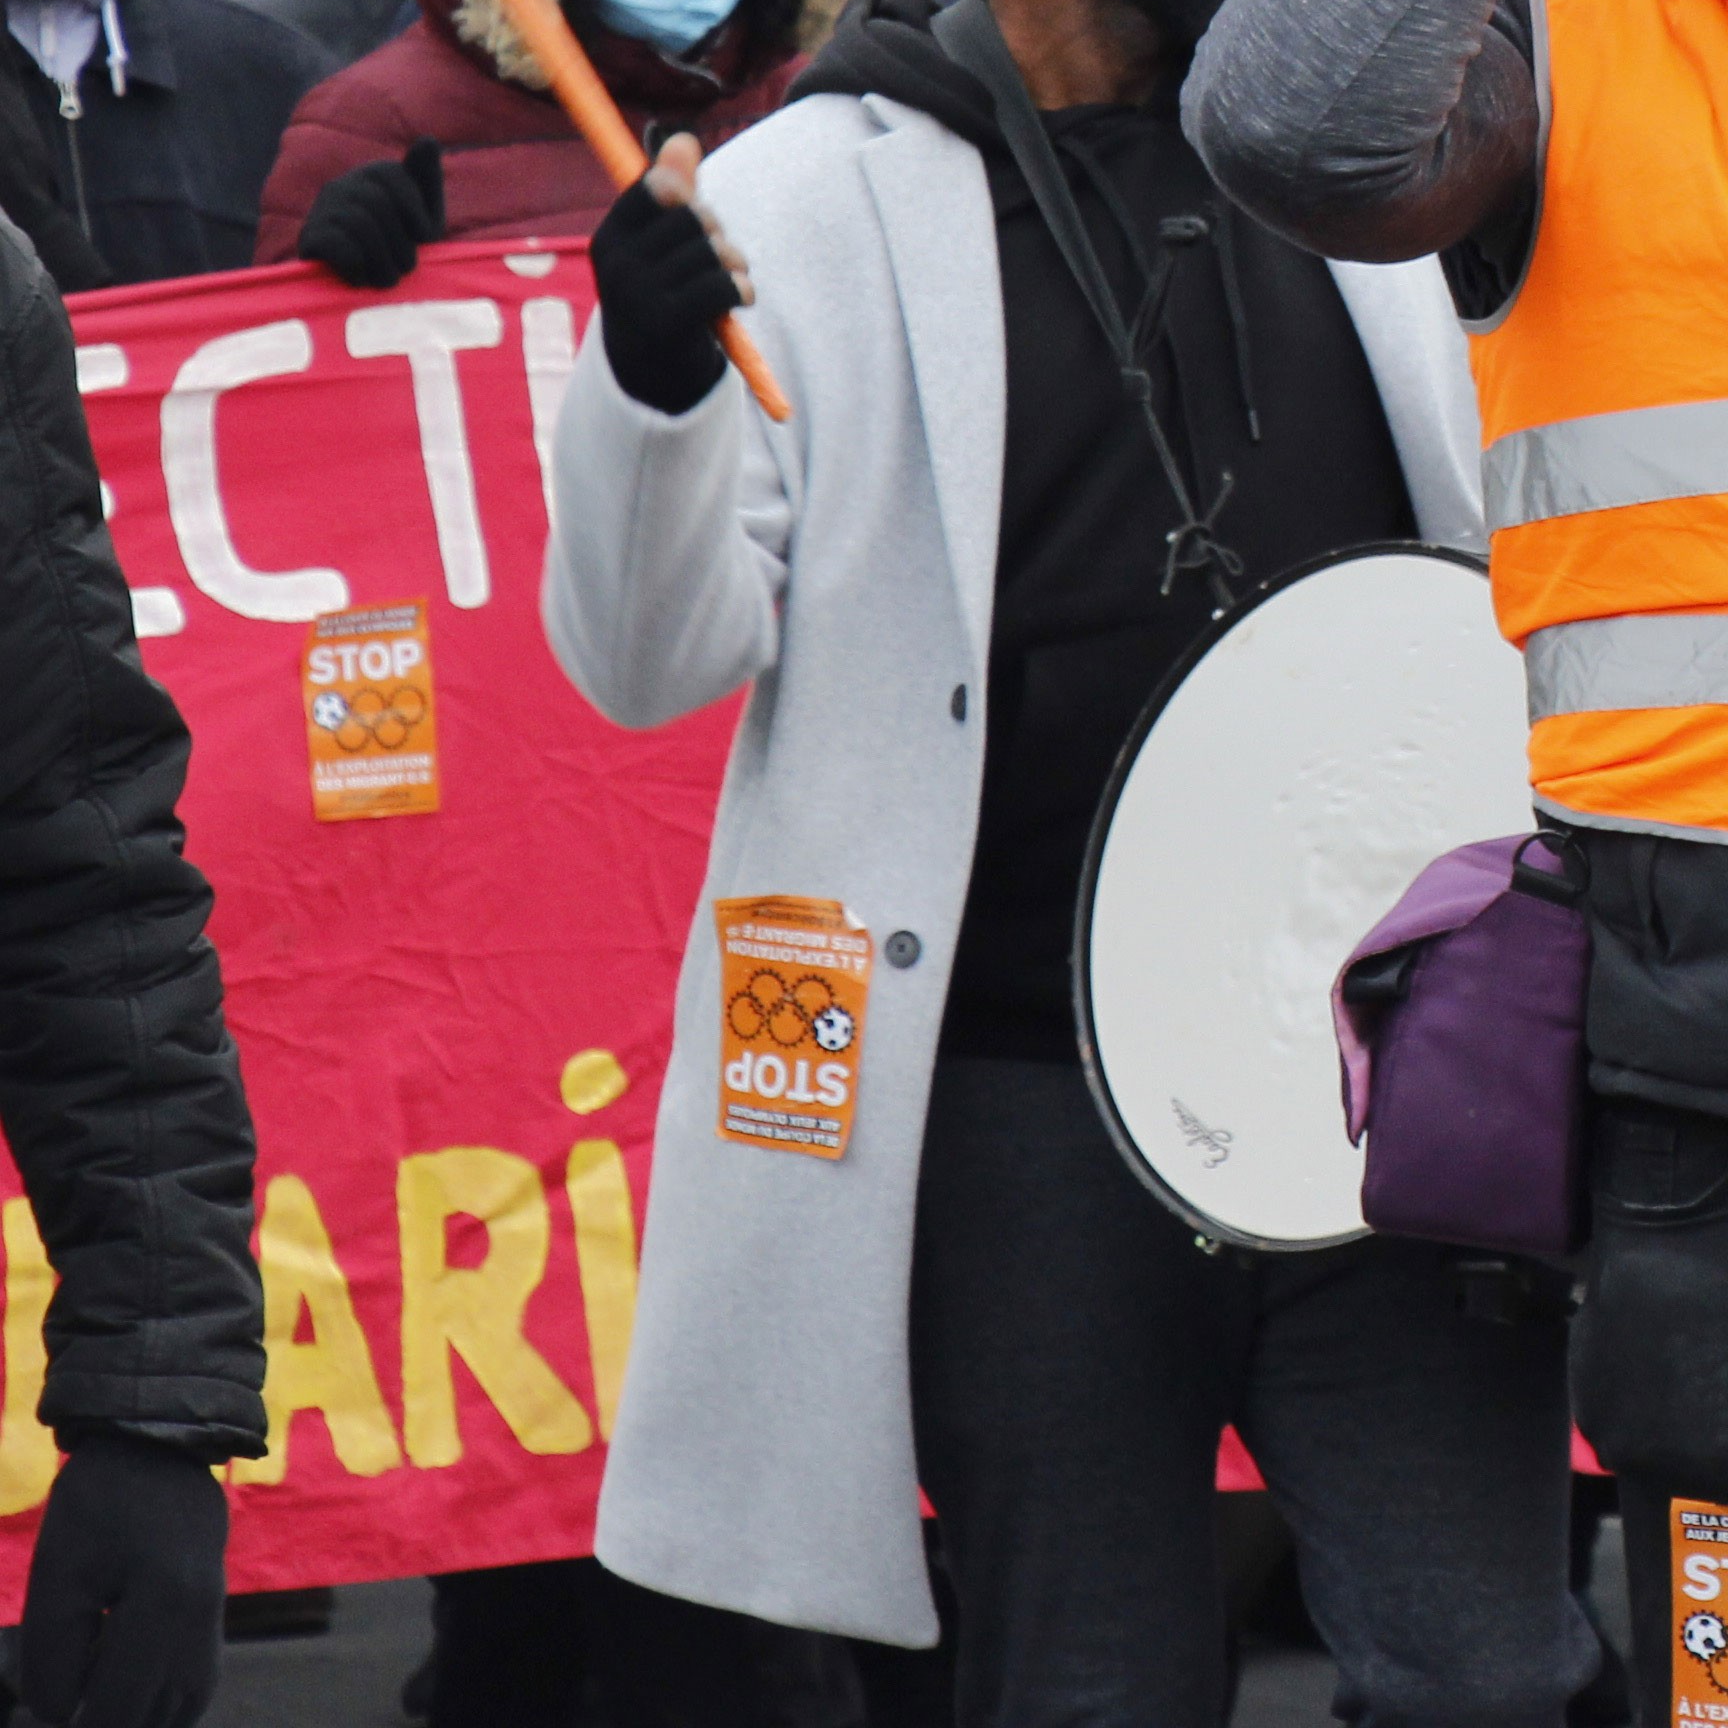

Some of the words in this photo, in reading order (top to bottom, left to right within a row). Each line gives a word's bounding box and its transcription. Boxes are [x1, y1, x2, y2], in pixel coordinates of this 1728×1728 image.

[307, 636, 424, 685] STOP
[725, 1051, 851, 1107] STOP
[1681, 1512, 1700, 1526] DE
[1701, 1515, 1720, 1527] LA
[1685, 1528, 1715, 1541] AUX
[1678, 1695, 1692, 1717] À
